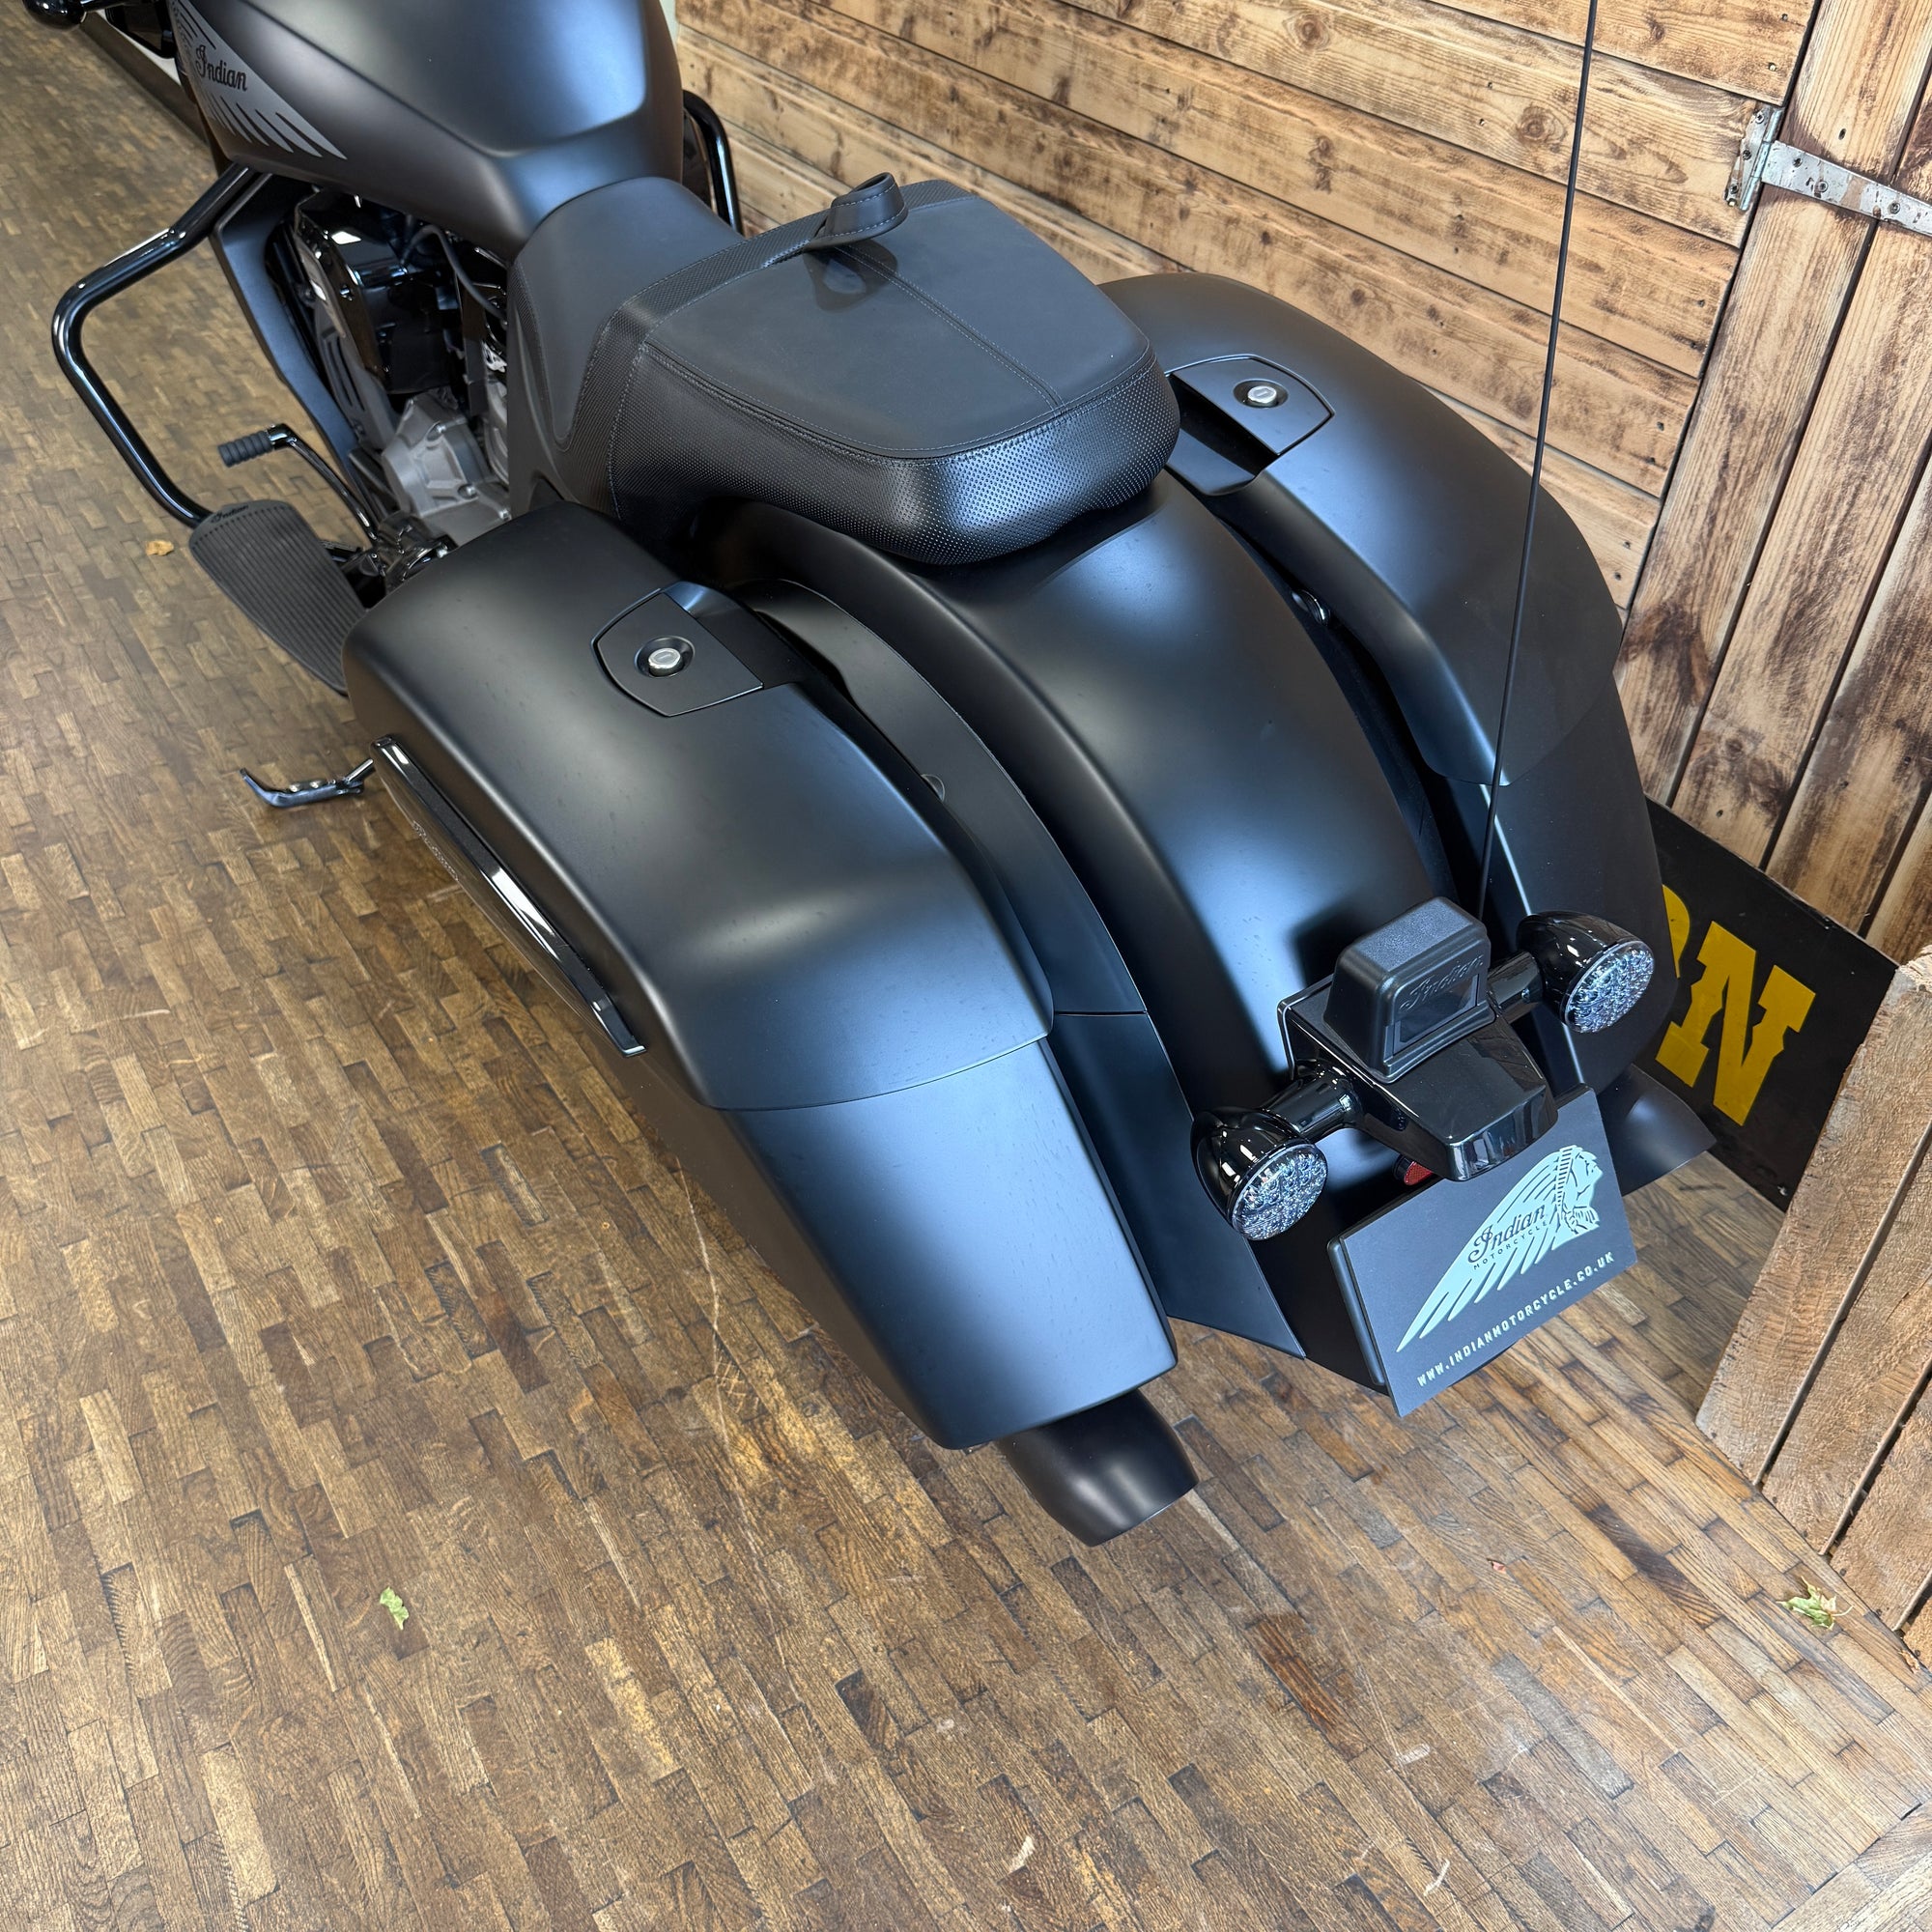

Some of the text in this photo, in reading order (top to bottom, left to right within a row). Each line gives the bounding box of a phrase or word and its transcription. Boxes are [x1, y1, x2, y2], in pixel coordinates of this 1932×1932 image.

[196, 44, 248, 92] Indian
[1399, 954, 1484, 1011] Indian
[1656, 883, 1816, 1127] N
[1467, 1204, 1546, 1264] Indian
[1473, 1220, 1548, 1270] MOTORCYCLE
[1416, 1251, 1615, 1388] WWW.INDIANMOTORCYCLE.CO.UK
